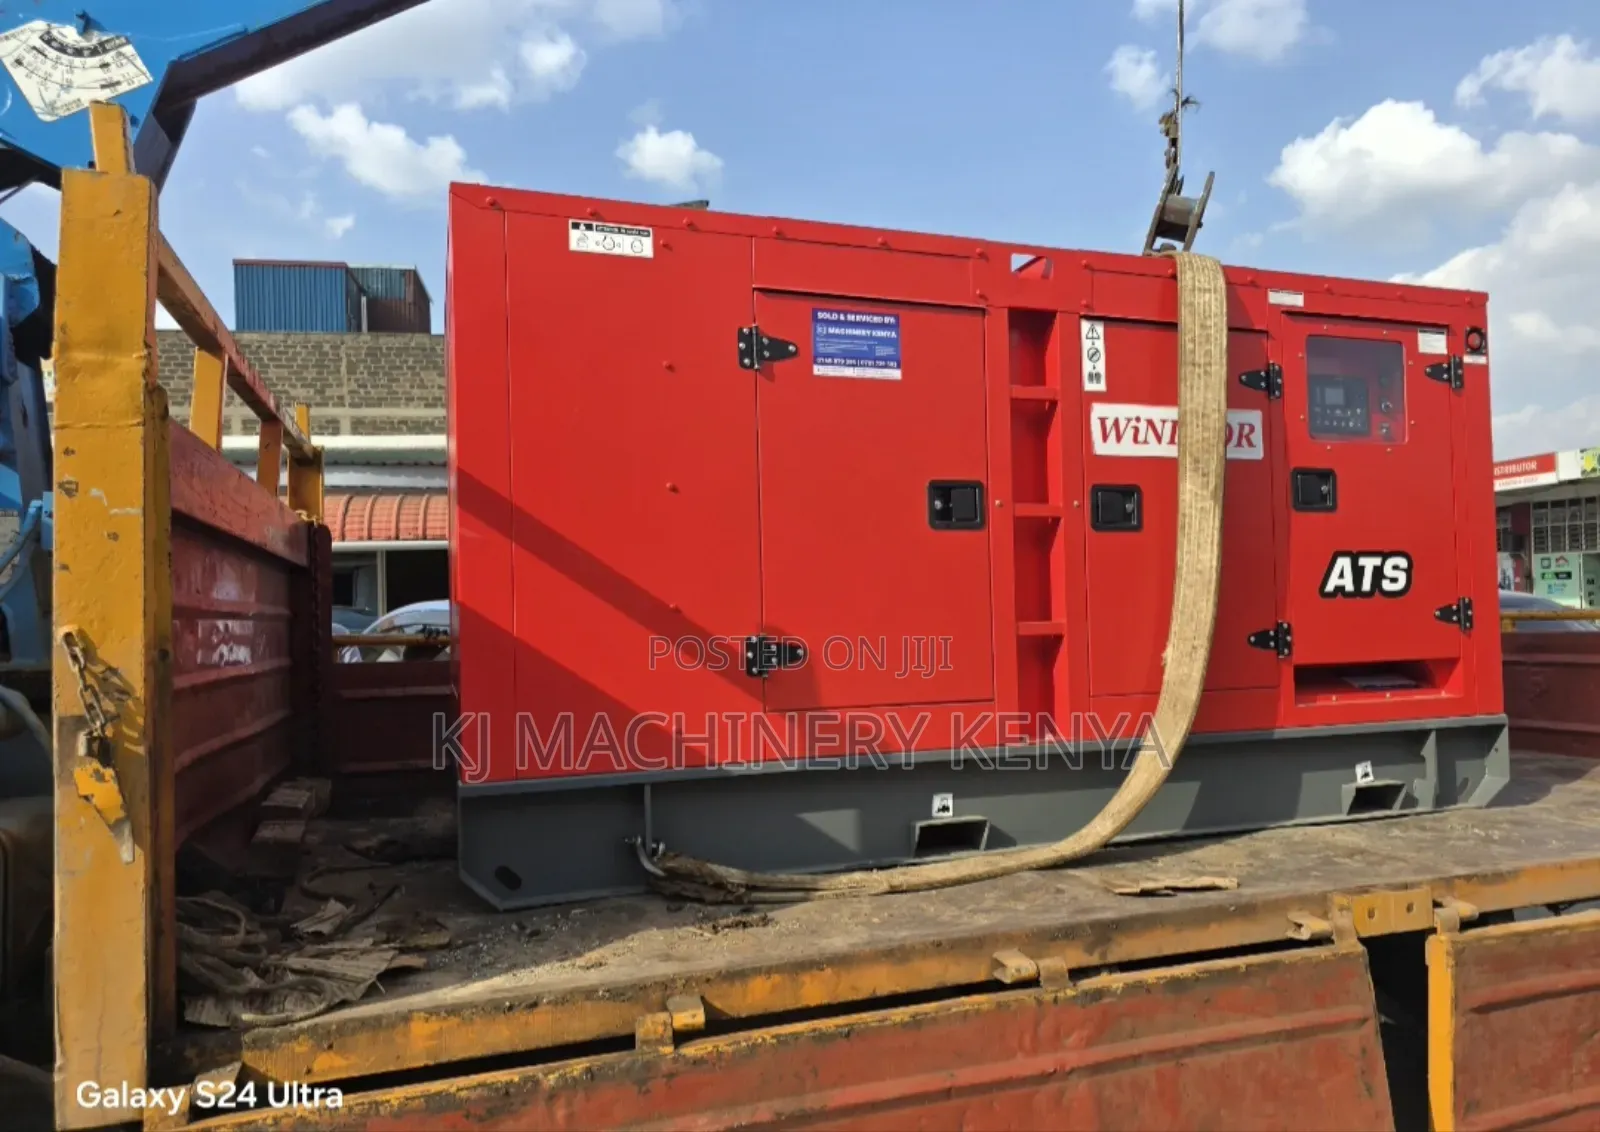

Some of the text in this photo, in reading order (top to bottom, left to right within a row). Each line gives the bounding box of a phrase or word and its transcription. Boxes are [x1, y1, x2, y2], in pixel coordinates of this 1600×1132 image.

[817, 311, 838, 321] SOLD
[840, 313, 846, 321] &
[847, 313, 884, 324] SERVICED
[1097, 415, 1258, 450] WiNR
[1493, 460, 1538, 477] ISTRIBUTOR
[1322, 553, 1410, 595] ATS
